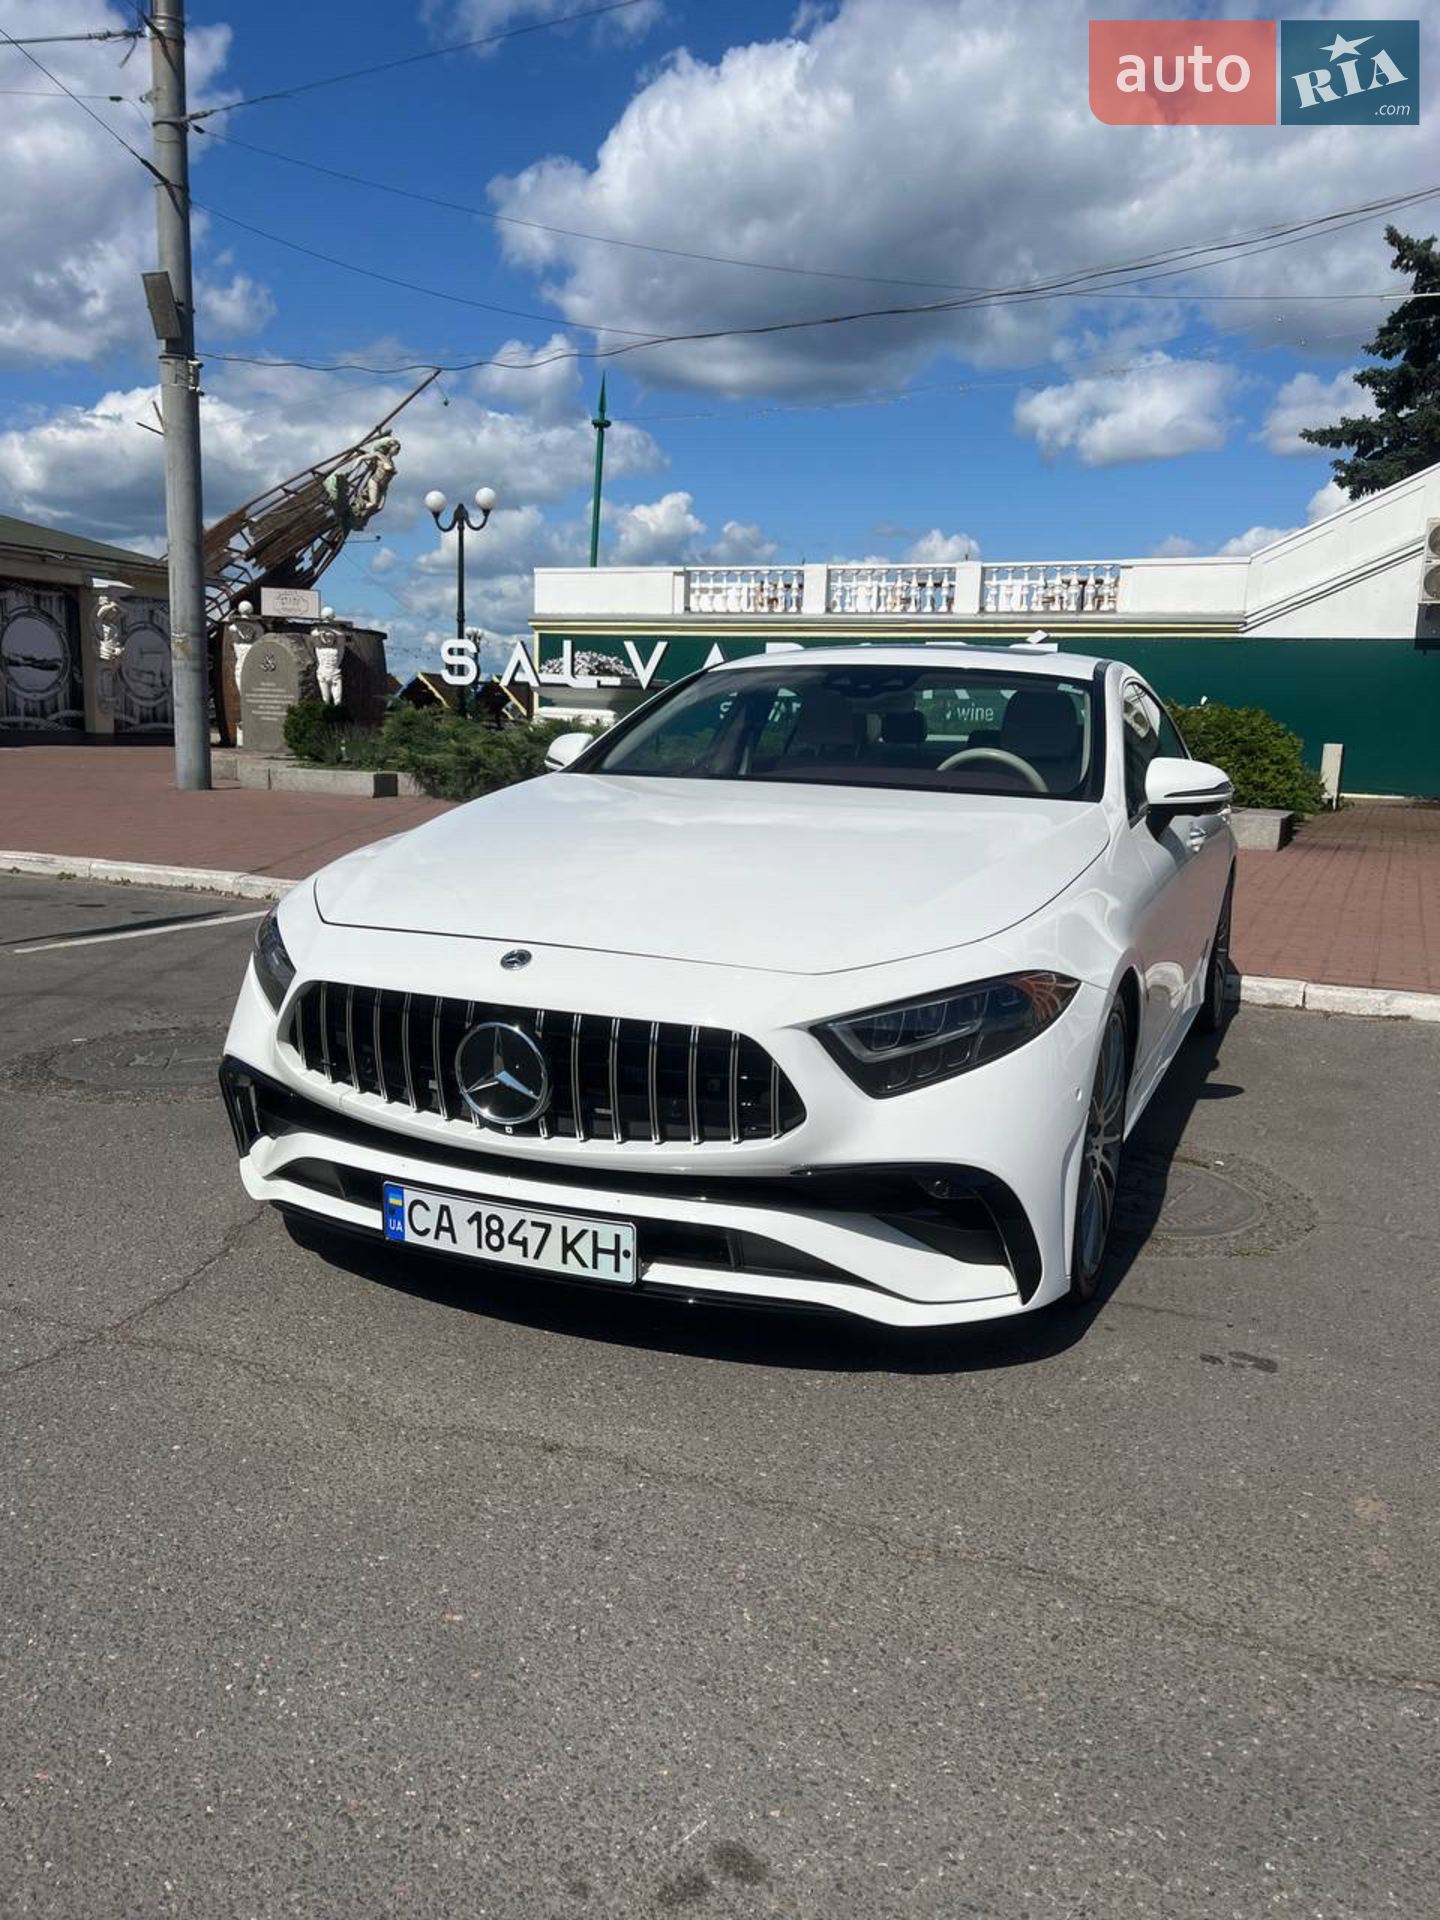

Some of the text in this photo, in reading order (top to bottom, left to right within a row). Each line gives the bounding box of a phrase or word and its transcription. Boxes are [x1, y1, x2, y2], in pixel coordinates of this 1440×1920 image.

[957, 702, 995, 722] wine
[388, 1217, 404, 1233] UA
[407, 1198, 622, 1274] CA 1847 KH
